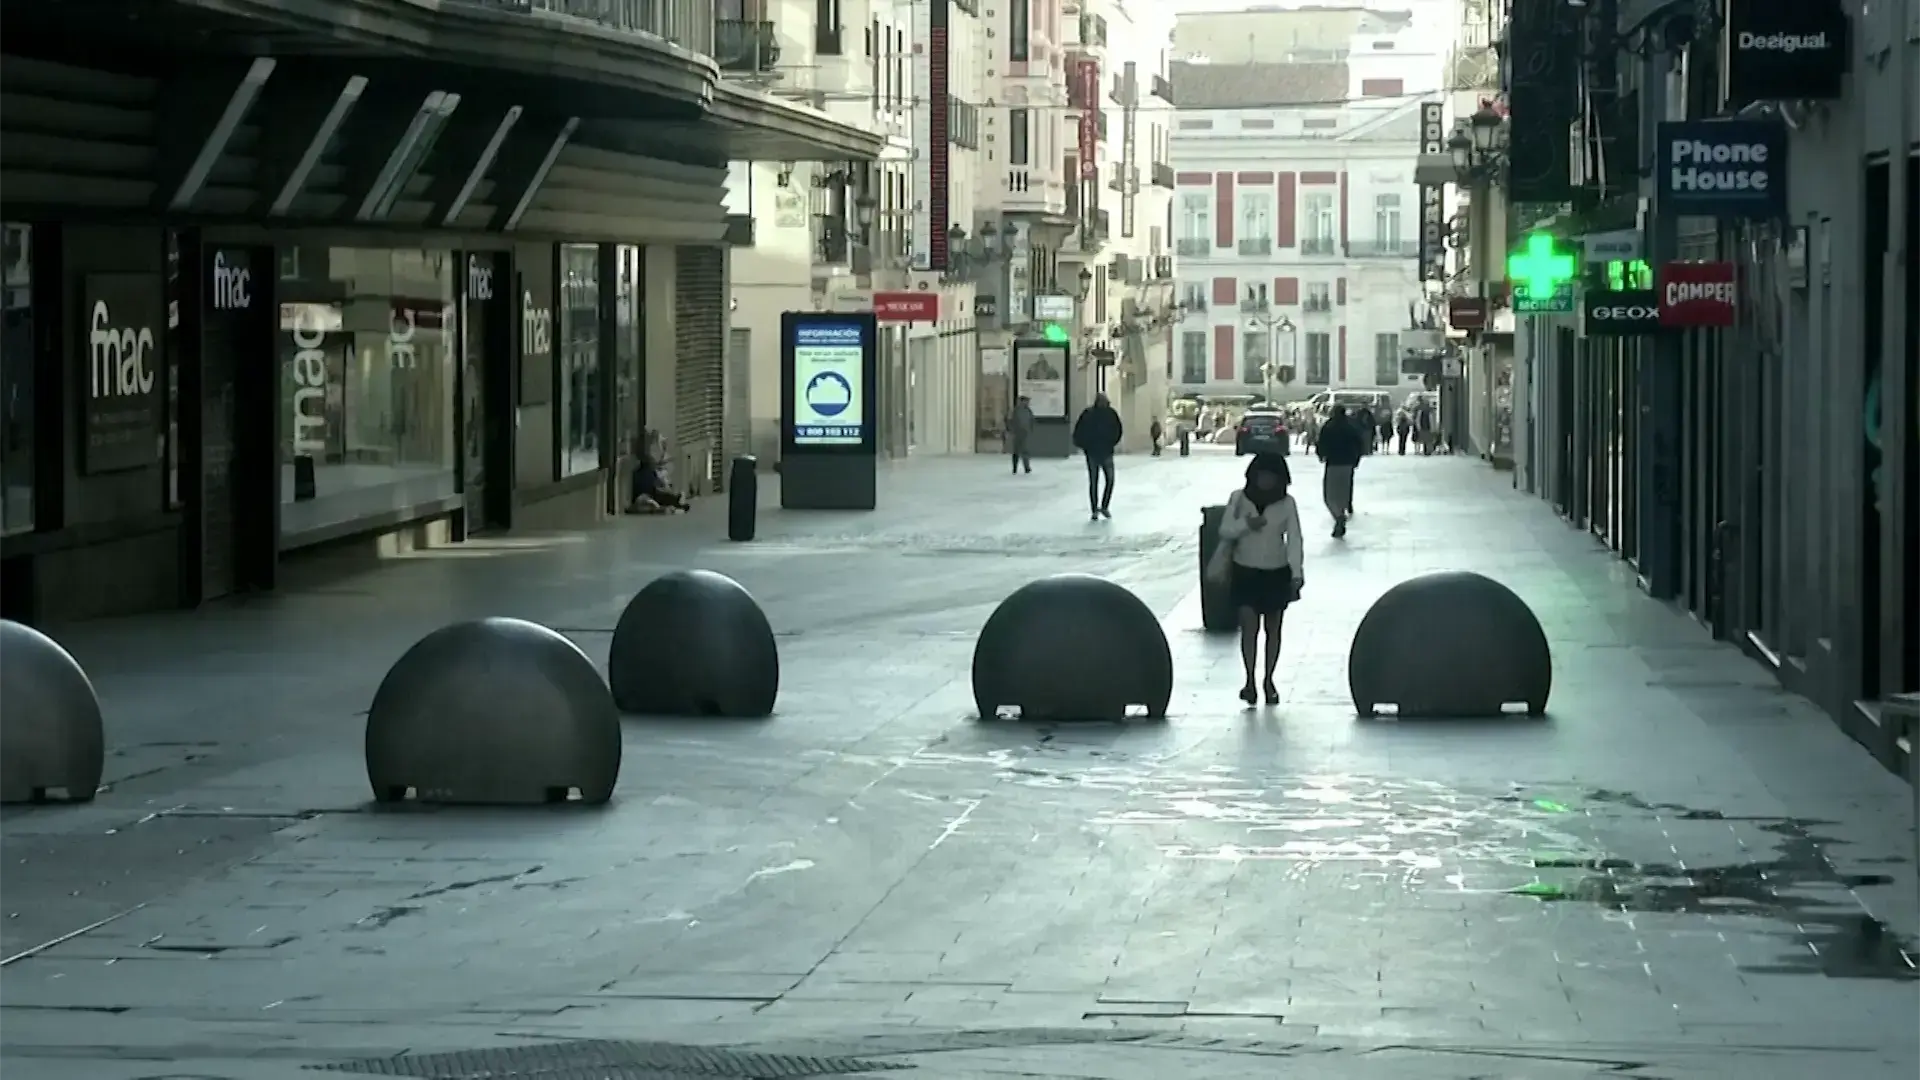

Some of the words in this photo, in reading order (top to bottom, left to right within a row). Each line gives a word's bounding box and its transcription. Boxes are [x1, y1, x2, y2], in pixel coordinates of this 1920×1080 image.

[1672, 140, 1768, 163] Phone
[1672, 168, 1768, 190] House
[214, 249, 251, 309] fnac
[468, 253, 493, 300] fnac
[1666, 281, 1735, 306] CAMPER
[522, 289, 550, 355] fnac
[1592, 306, 1660, 320] GEOX
[90, 299, 154, 398] fnac
